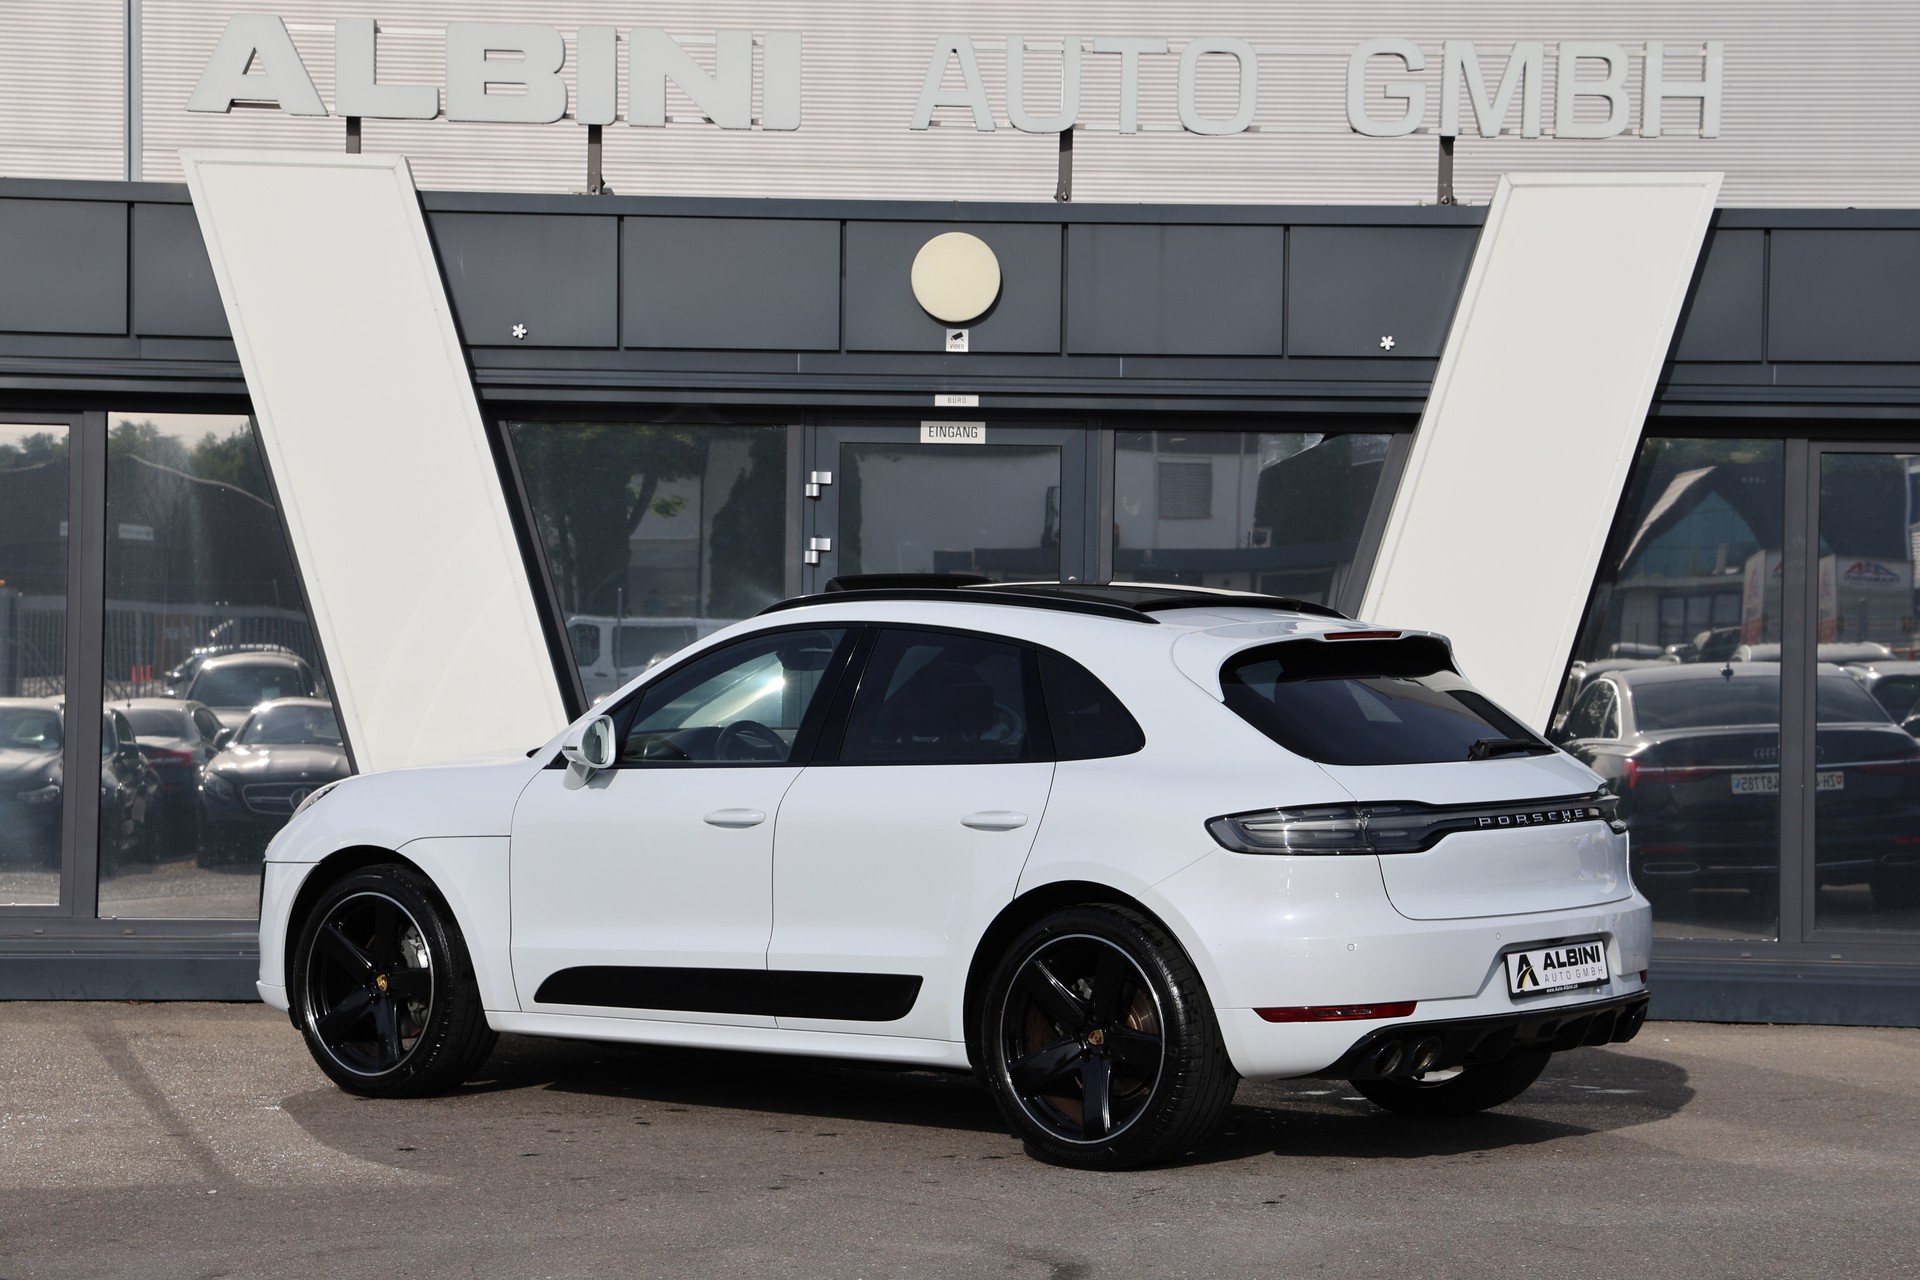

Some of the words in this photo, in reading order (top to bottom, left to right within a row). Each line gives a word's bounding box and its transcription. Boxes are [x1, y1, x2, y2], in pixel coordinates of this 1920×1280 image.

[186, 13, 801, 131] ALBINI
[908, 34, 1258, 135] AUTO
[1345, 37, 1724, 140] GMBH
[947, 395, 967, 404] BÜRO
[928, 425, 978, 439] EINGANG
[1478, 808, 1584, 827] PORSCHE
[1543, 945, 1601, 971] ALBINI
[1544, 970, 1571, 983] AUTO
[1575, 966, 1604, 978] GMBH
